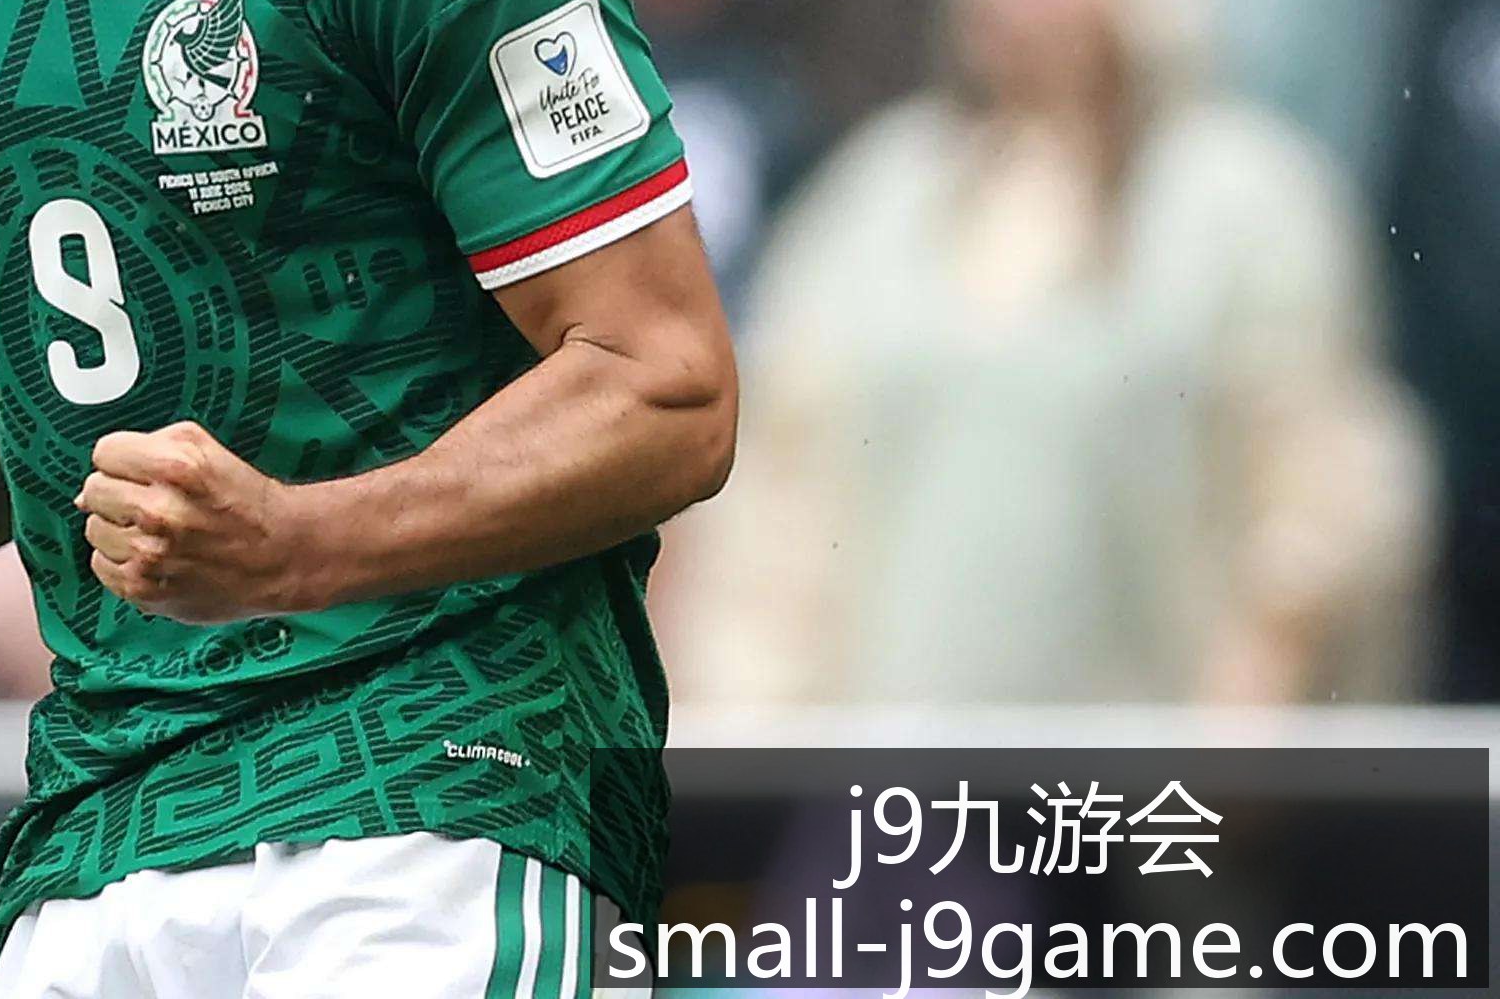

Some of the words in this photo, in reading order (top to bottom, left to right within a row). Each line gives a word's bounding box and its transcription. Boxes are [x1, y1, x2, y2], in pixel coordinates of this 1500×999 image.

[549, 92, 610, 134] PEACE
[157, 121, 260, 148] MÉXICO
[571, 126, 603, 145] FIFA
[29, 199, 139, 404] 9
